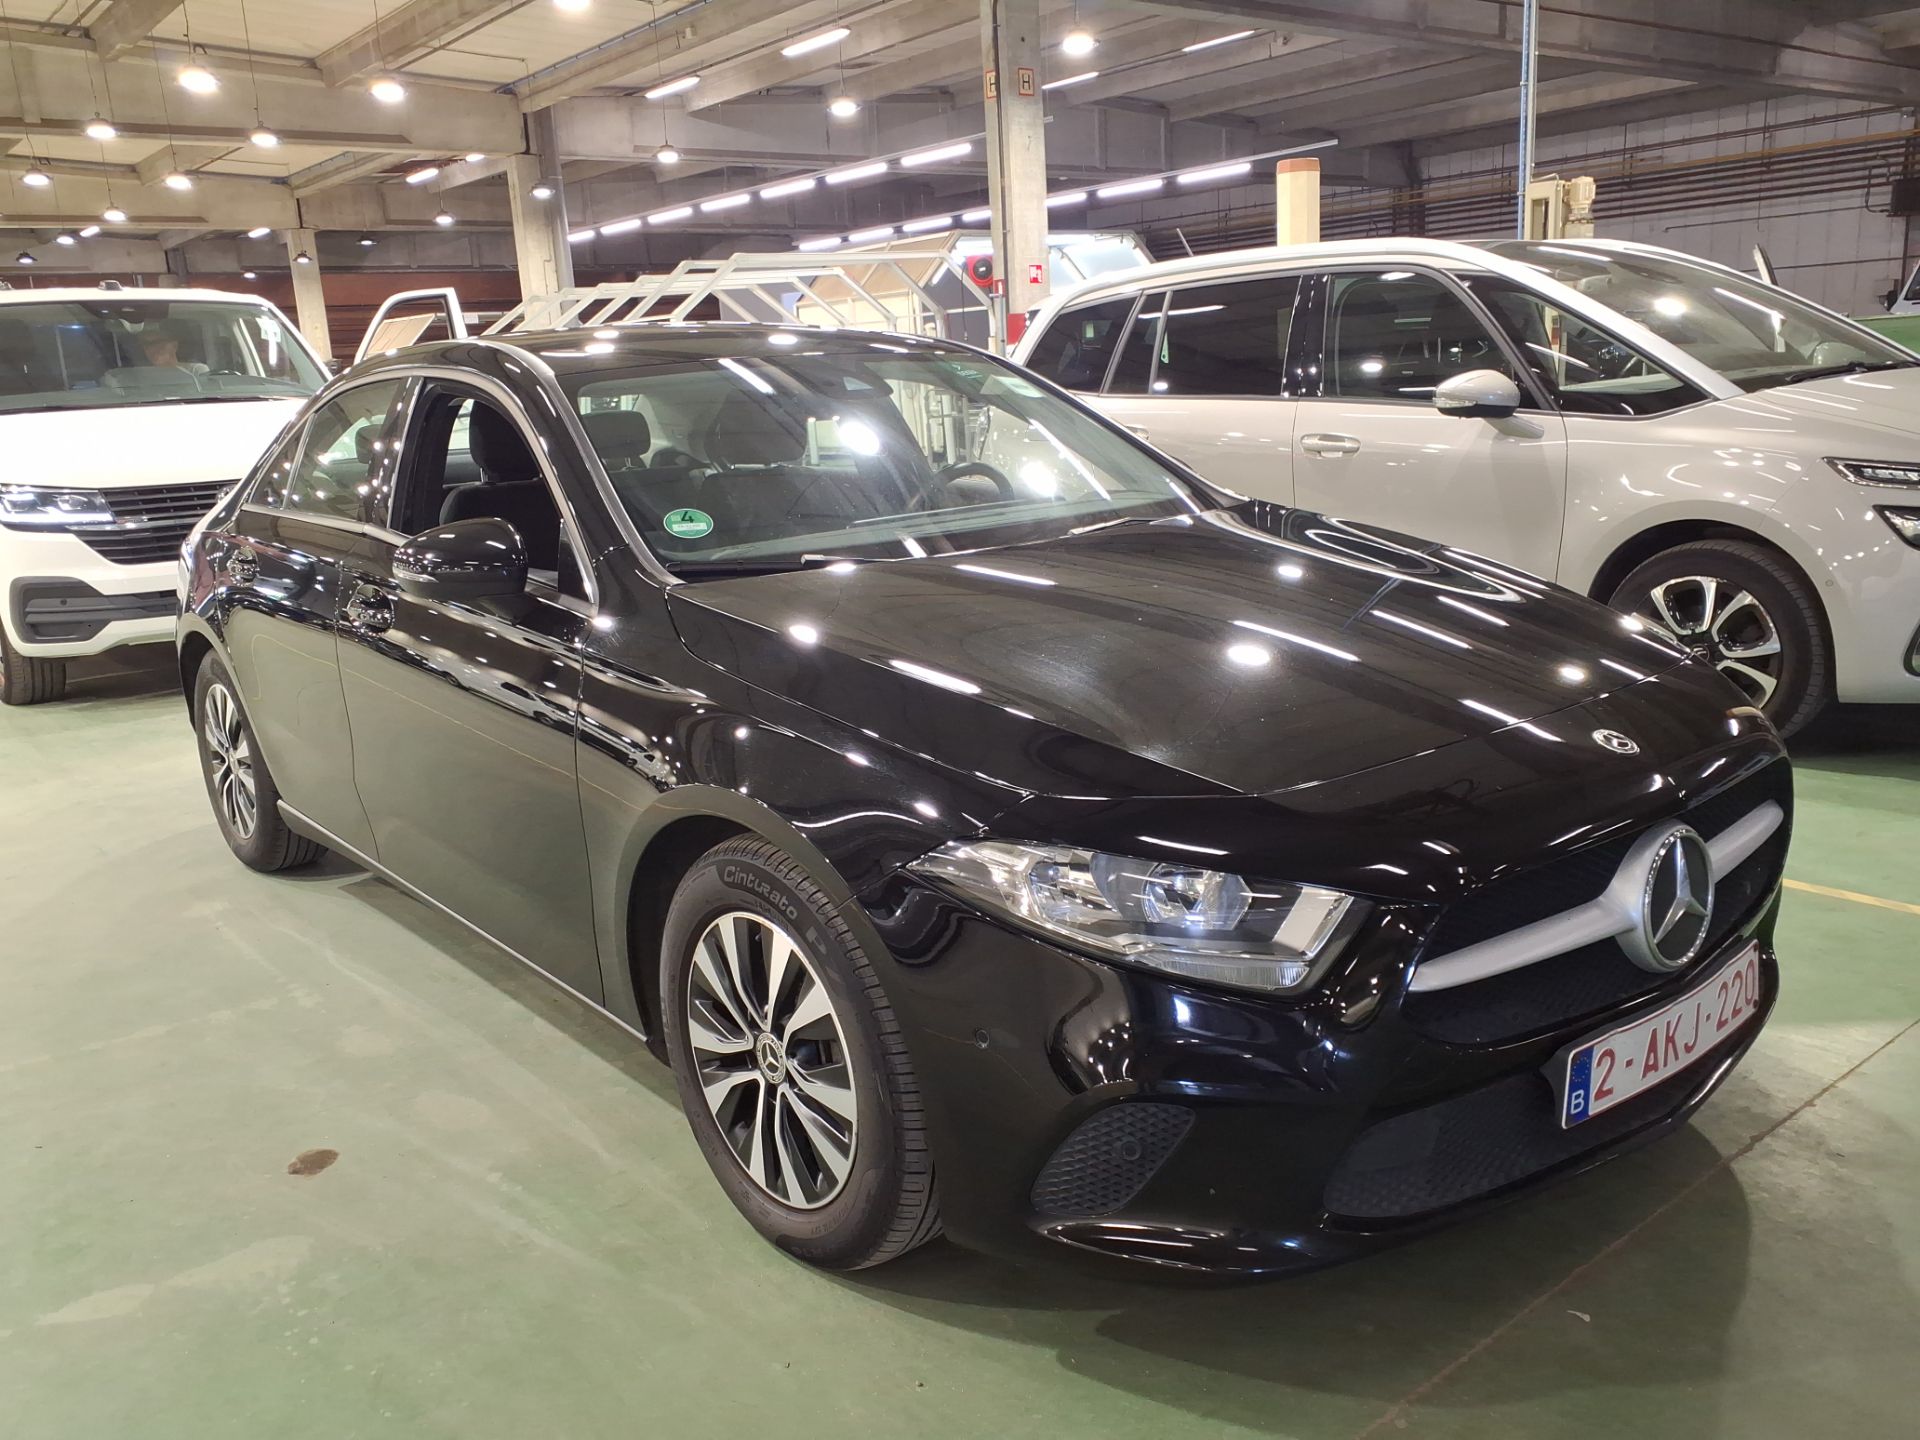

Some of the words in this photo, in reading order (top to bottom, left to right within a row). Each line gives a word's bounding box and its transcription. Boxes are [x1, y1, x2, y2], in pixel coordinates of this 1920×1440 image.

[1022, 73, 1031, 91] H
[681, 511, 694, 523] 4
[723, 865, 798, 920] Cinturato
[1593, 959, 1757, 1101] 2-AKJ-220
[1570, 1088, 1585, 1114] B
